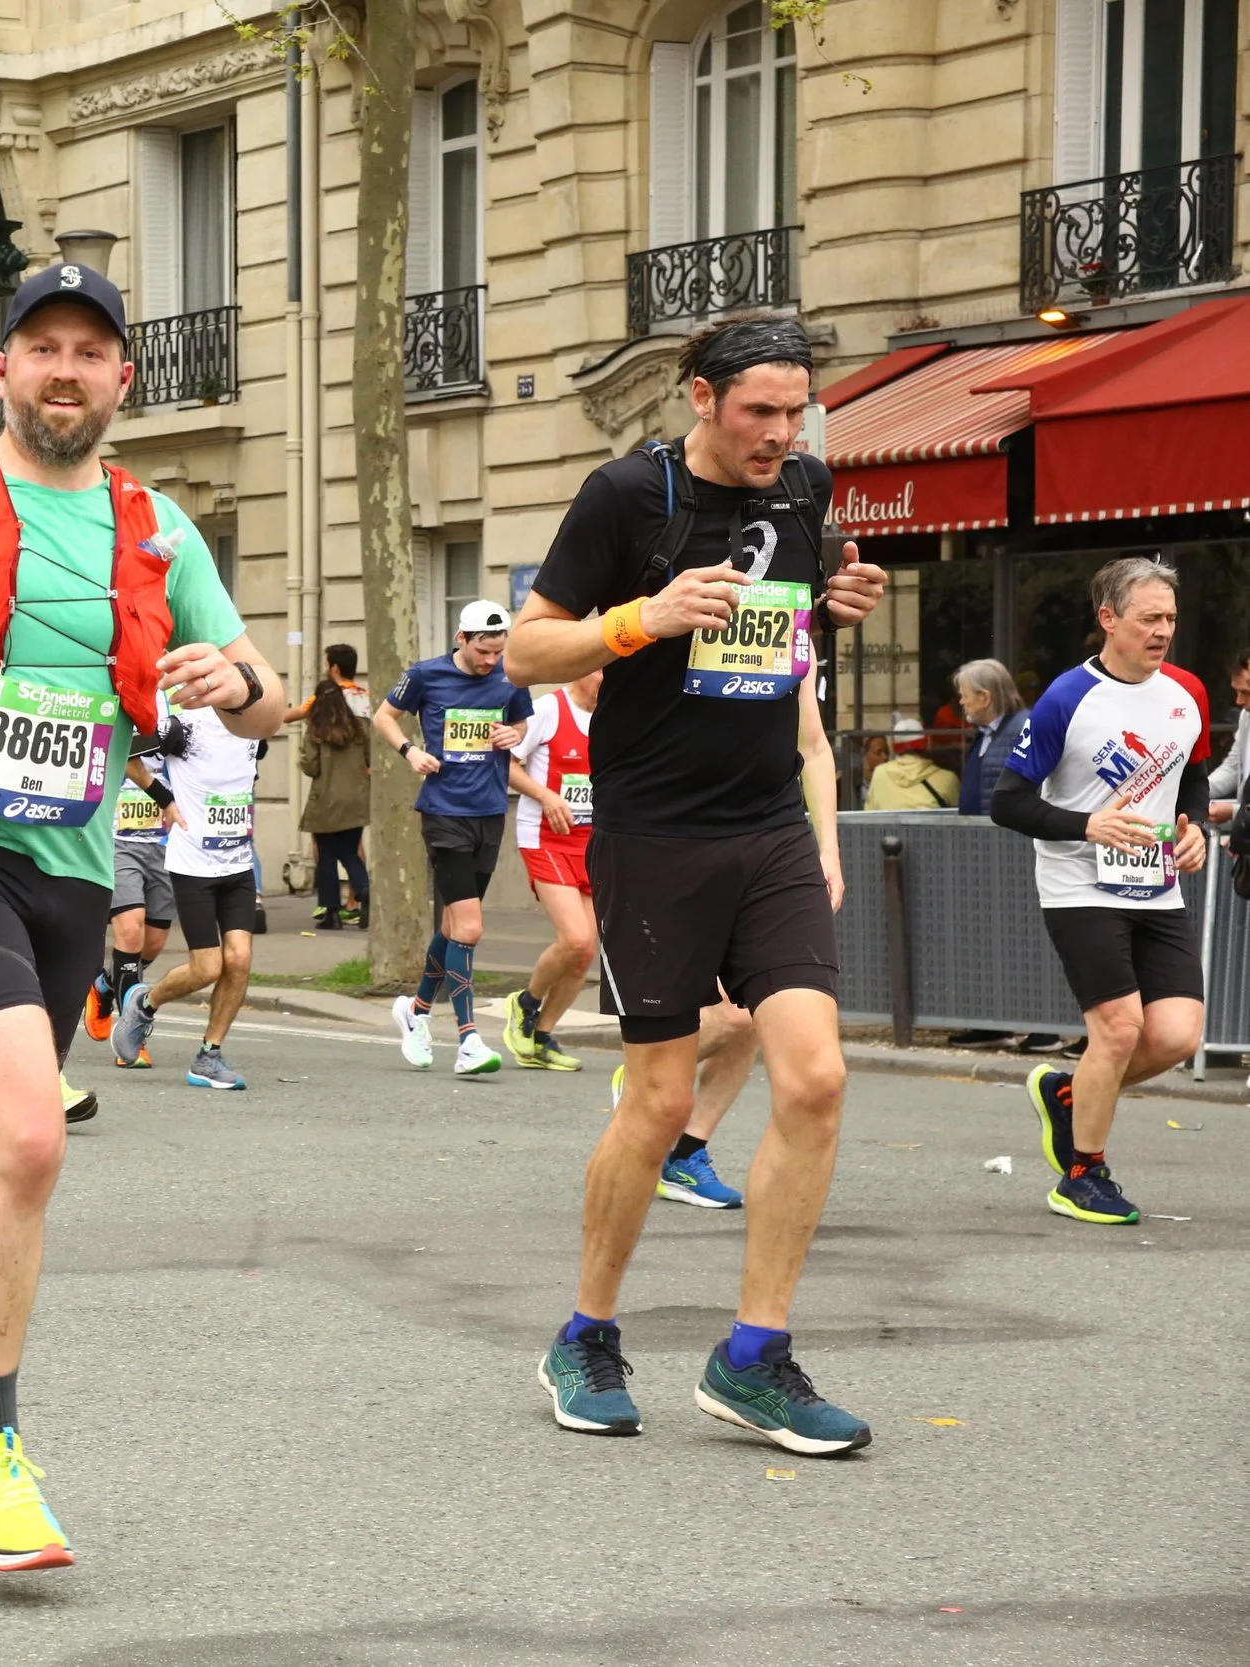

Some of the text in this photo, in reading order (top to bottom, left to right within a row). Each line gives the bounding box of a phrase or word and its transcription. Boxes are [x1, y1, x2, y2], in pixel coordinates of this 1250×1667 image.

[796, 628, 808, 645] 3h
[721, 652, 763, 667] pur sang
[795, 645, 809, 662] 45
[18, 681, 94, 709] Schneider
[53, 705, 90, 719] Electric
[450, 722, 490, 739] 36748
[91, 747, 106, 767] 3h
[1092, 739, 1117, 765] SEMI
[90, 767, 104, 786] 45
[1096, 752, 1136, 790] M
[21, 776, 43, 792] Ben
[122, 801, 160, 819] 37093
[208, 806, 246, 825] 34384
